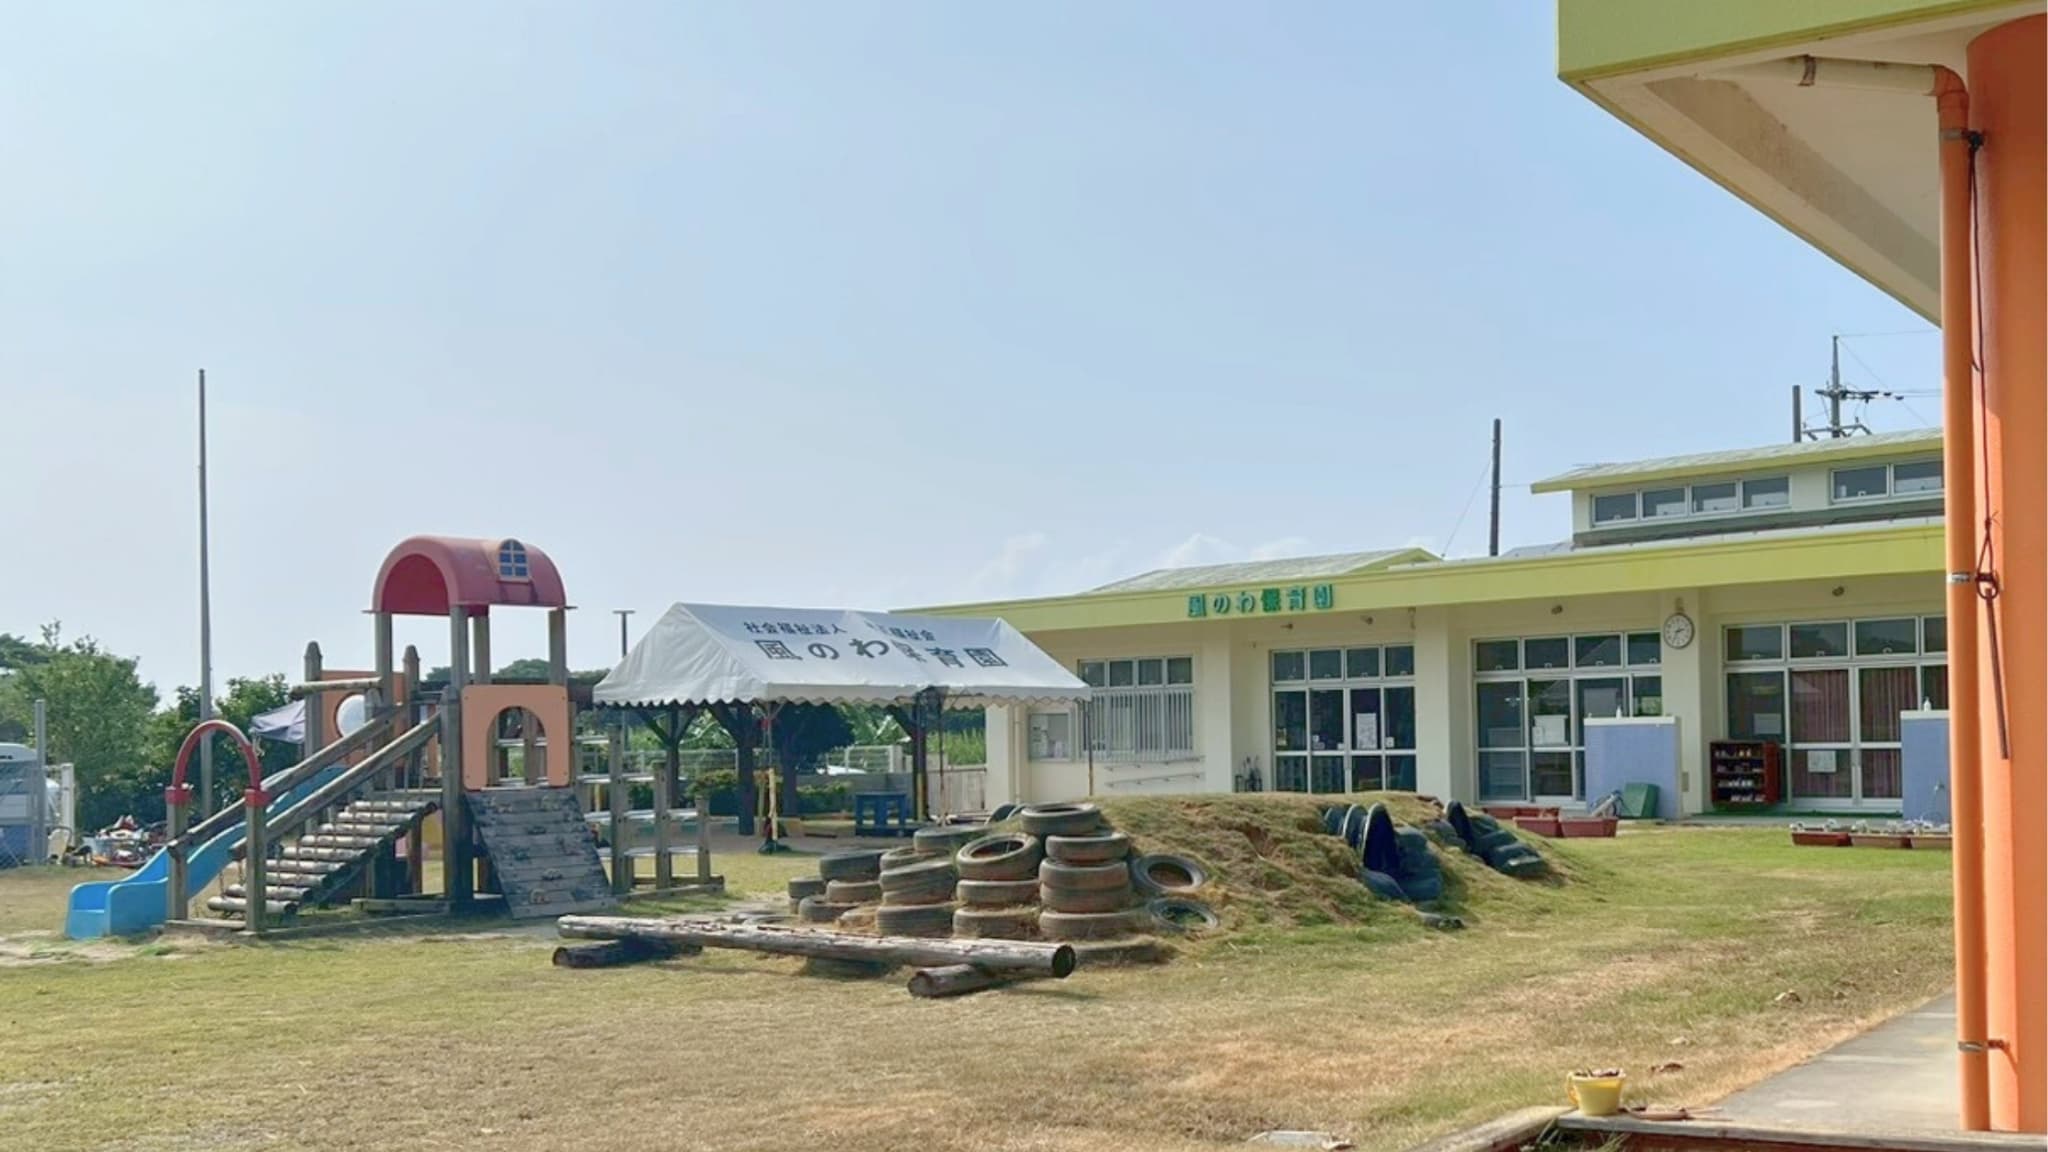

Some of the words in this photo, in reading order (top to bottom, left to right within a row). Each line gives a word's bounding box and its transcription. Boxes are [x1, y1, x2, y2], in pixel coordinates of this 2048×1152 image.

[1188, 584, 1333, 618] 風のわ保育園
[744, 621, 847, 635] 社会福祉法人
